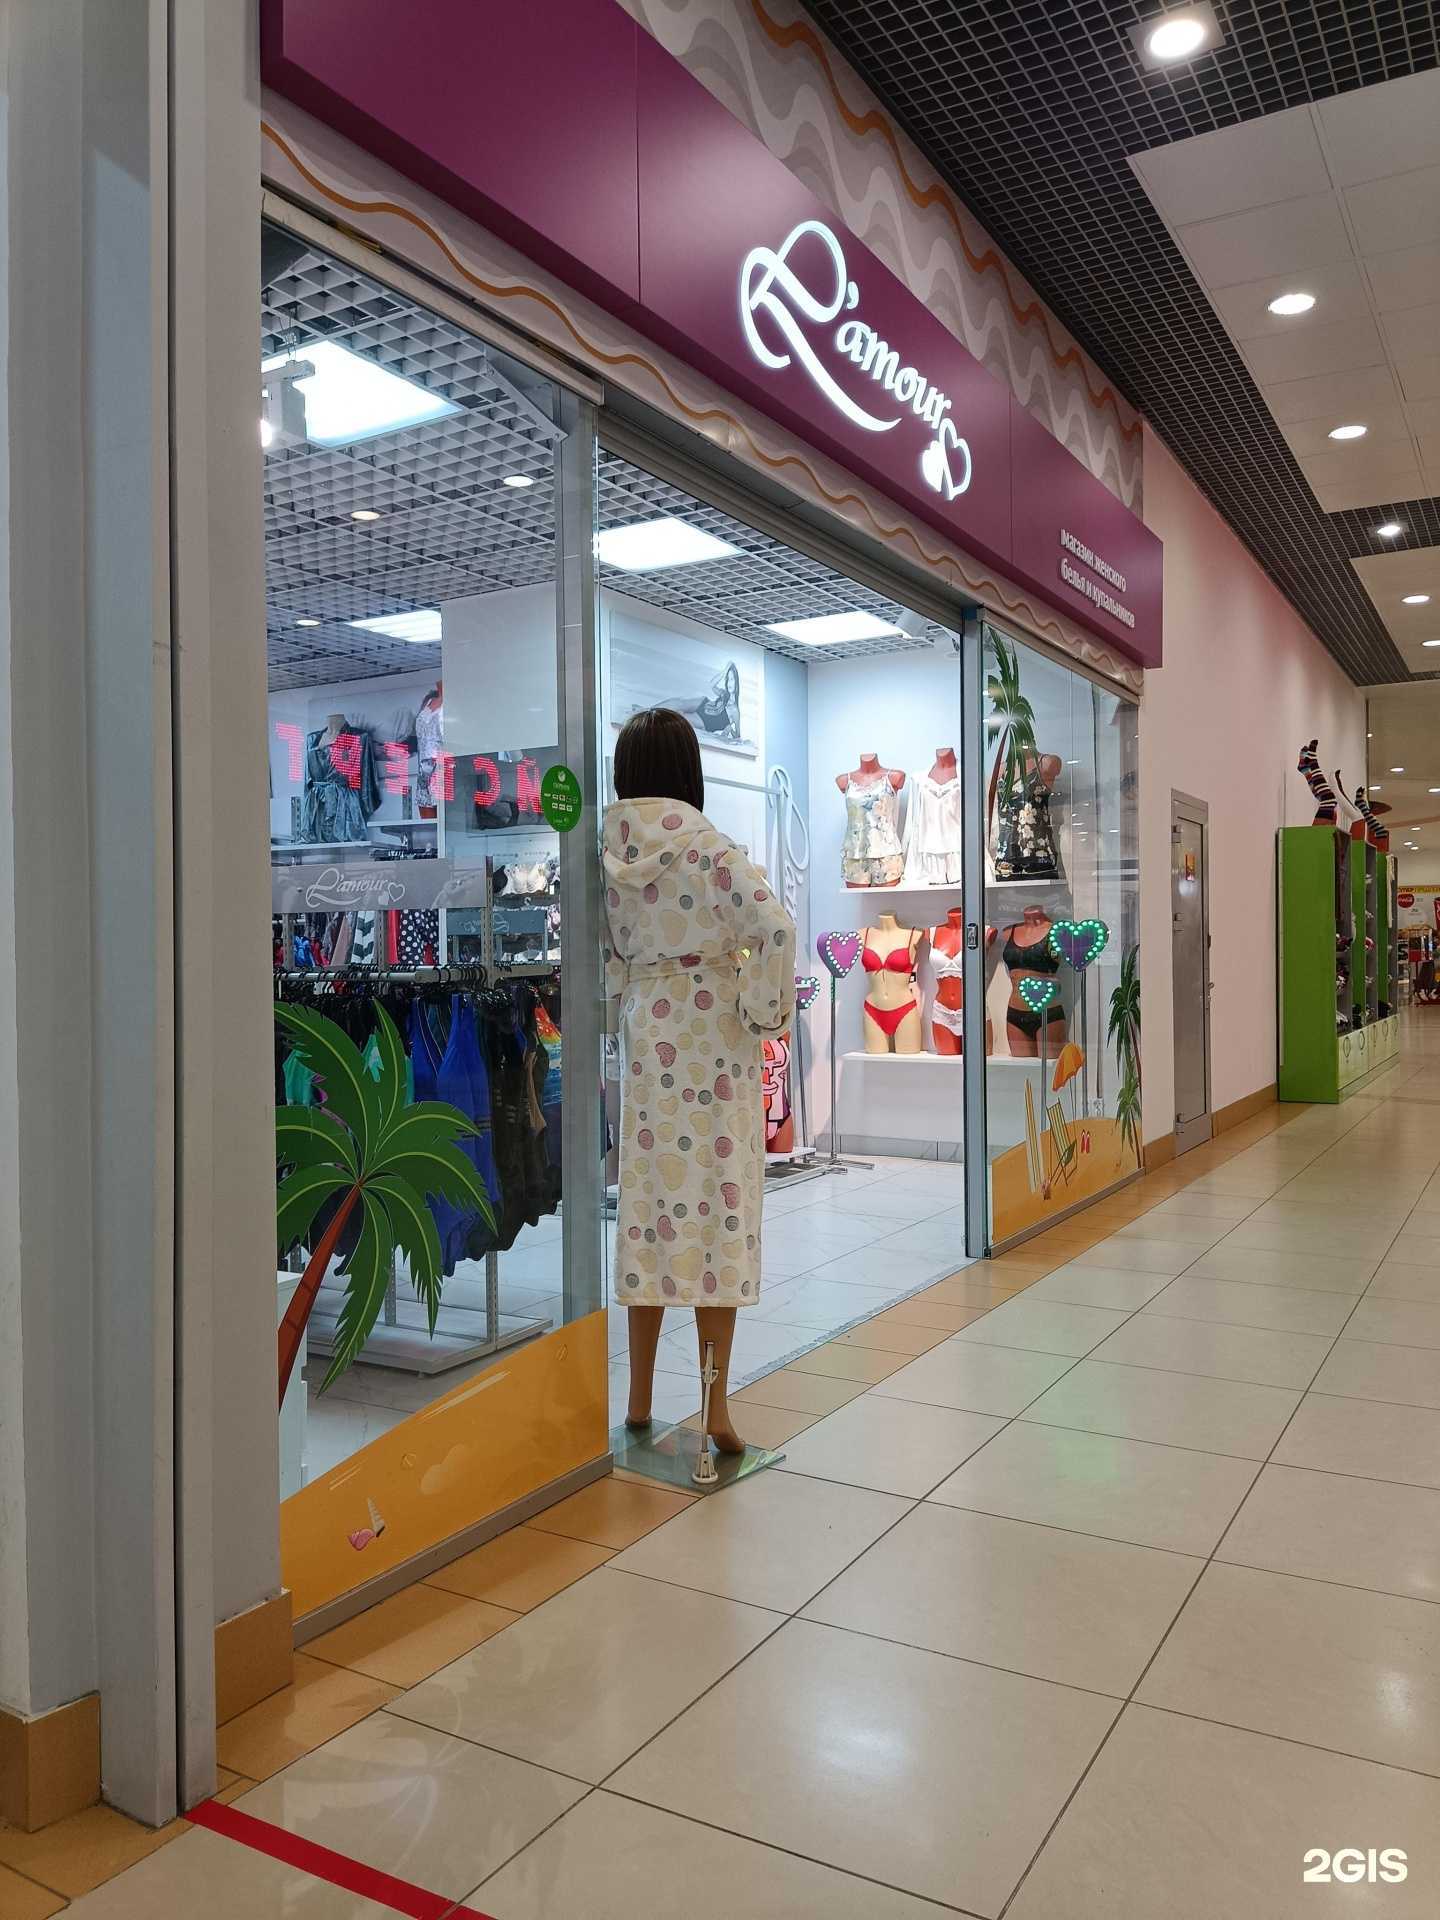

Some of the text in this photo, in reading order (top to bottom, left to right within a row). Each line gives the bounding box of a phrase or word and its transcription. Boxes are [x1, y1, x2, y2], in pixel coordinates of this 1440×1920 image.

[1060, 558, 1086, 593] белья
[1093, 584, 1136, 628] купальников
[1094, 554, 1127, 593] женского
[305, 867, 388, 908] L'amour
